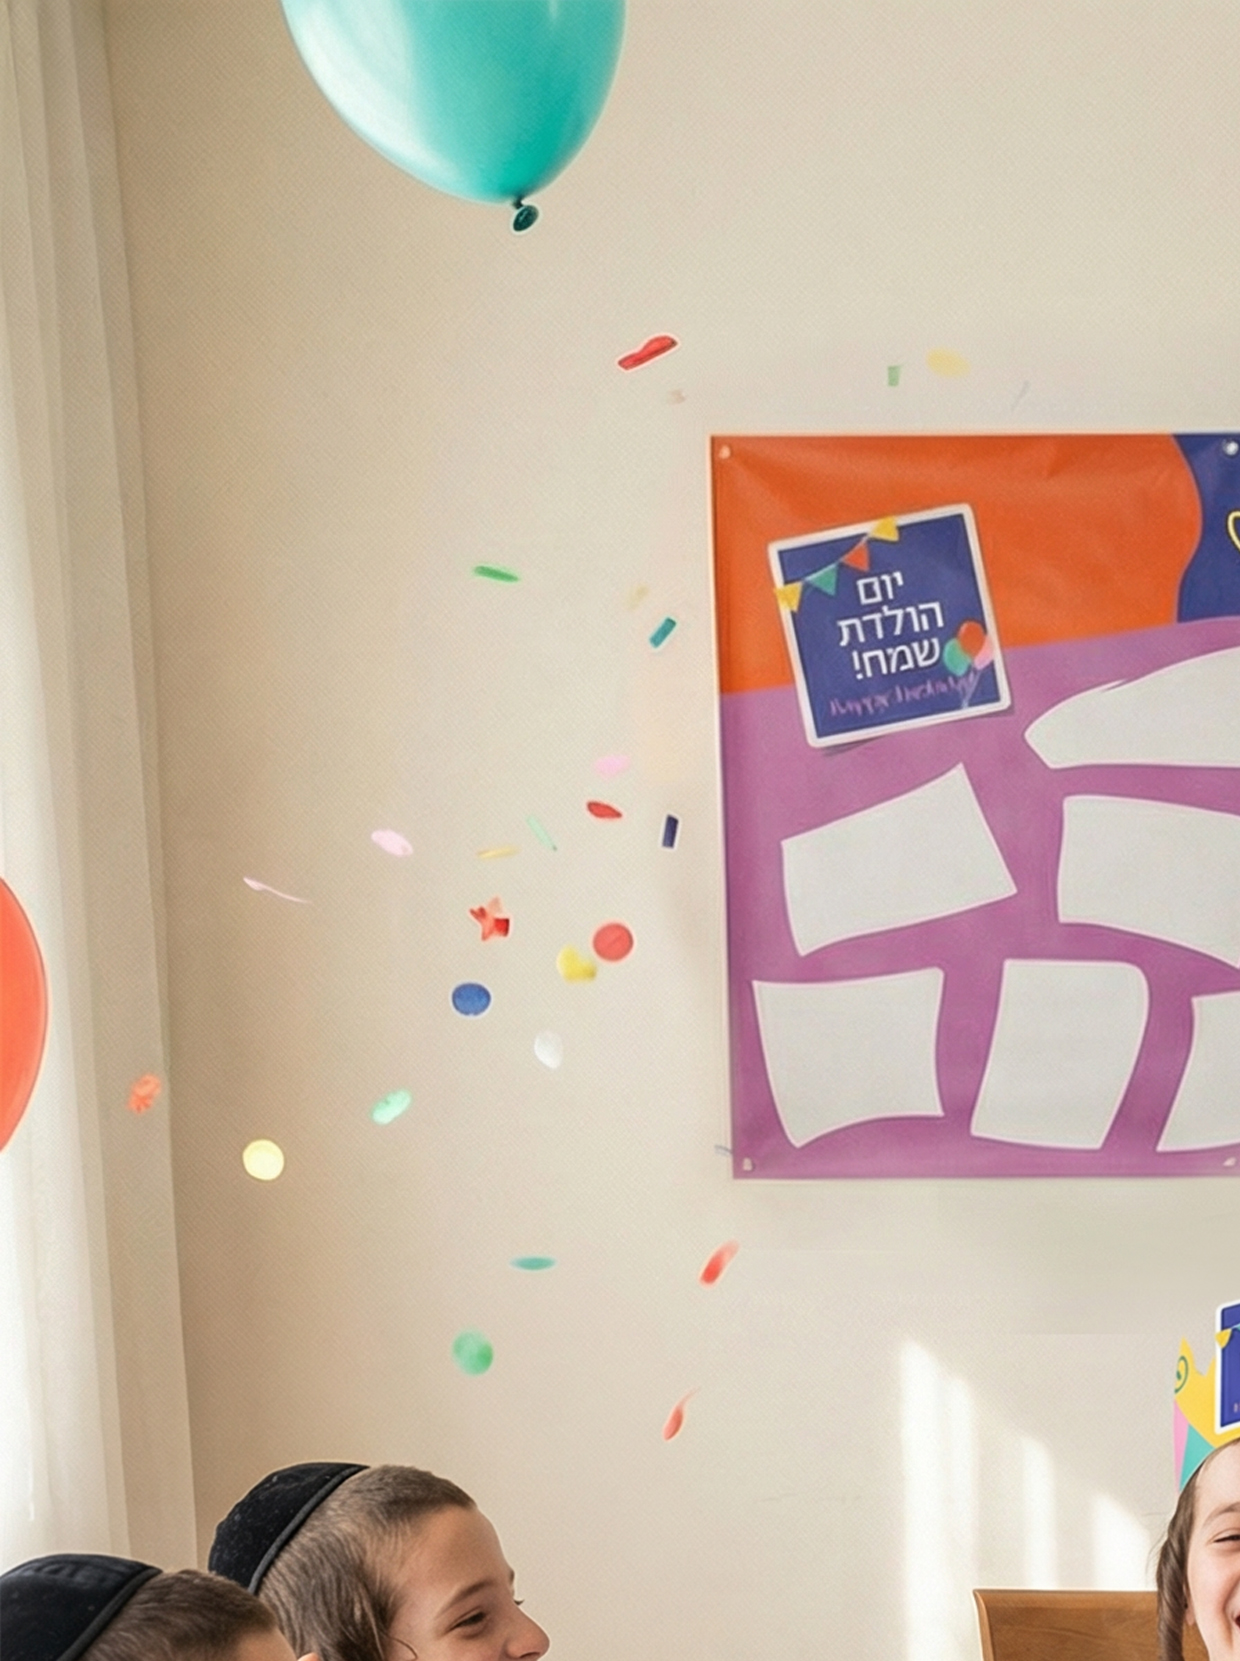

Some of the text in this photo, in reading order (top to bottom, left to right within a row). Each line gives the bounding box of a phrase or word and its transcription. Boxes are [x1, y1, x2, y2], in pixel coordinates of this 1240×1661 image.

[856, 571, 904, 605] יום
[837, 601, 944, 646] הולדת
[852, 637, 940, 680] שמח!
